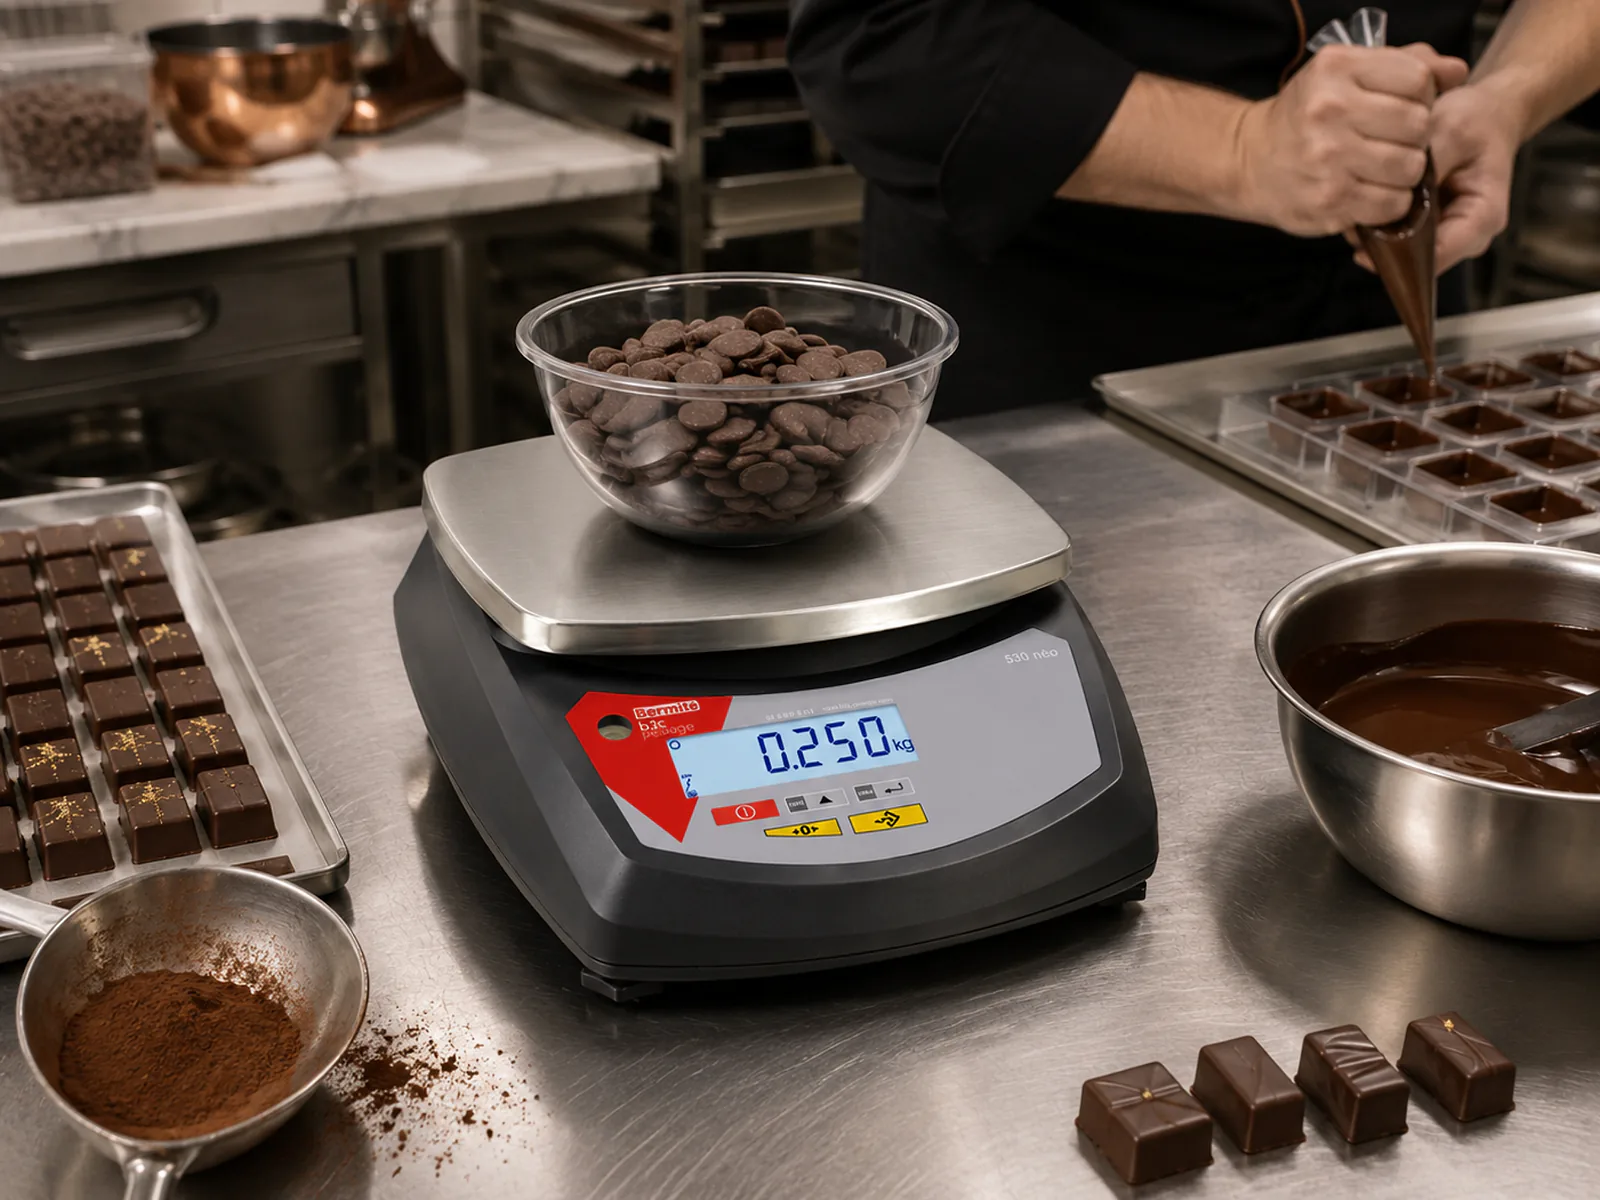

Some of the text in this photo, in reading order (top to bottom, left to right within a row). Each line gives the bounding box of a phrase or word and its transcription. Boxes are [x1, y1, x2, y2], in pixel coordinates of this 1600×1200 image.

[1004, 651, 1030, 664] 530
[757, 716, 915, 774] 0.250 kg
